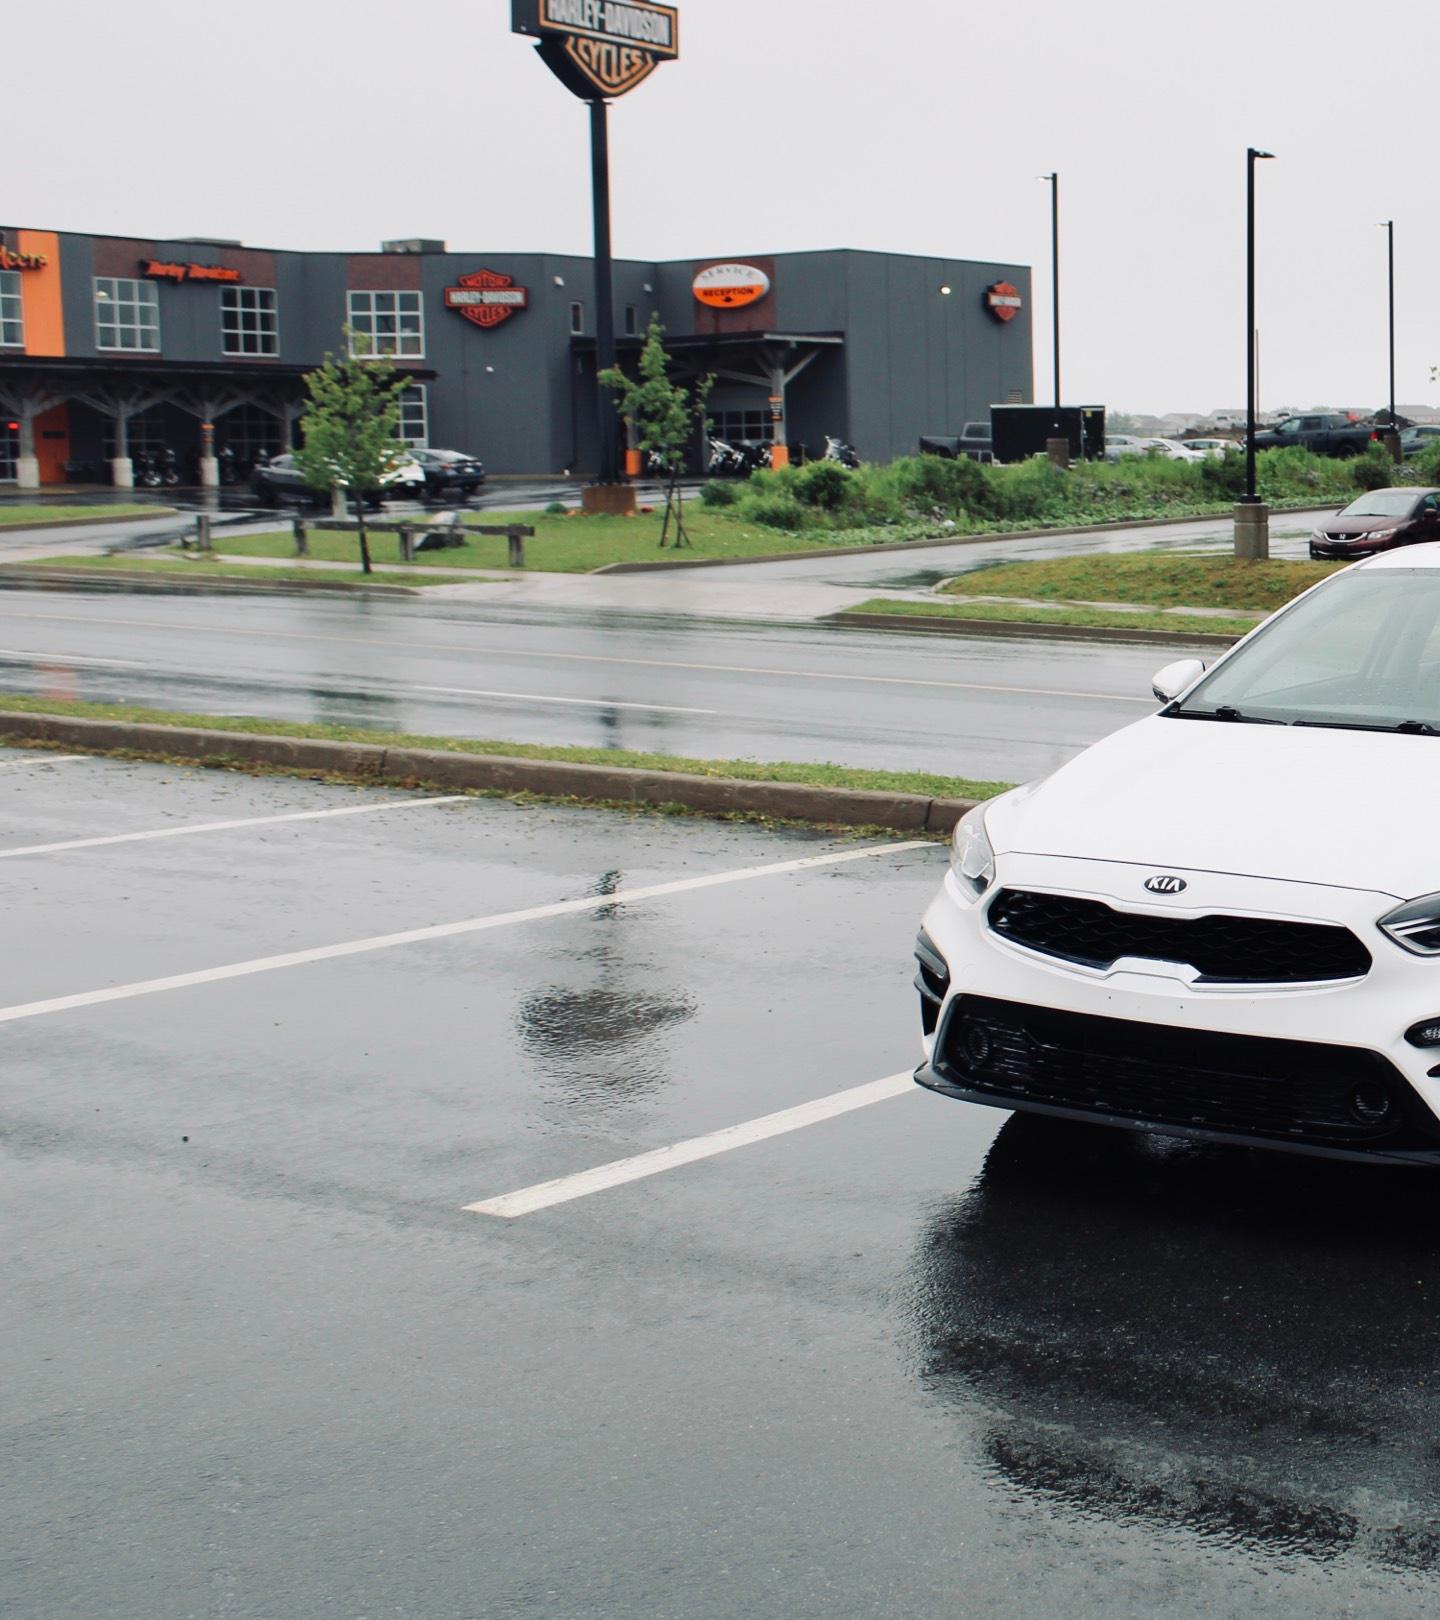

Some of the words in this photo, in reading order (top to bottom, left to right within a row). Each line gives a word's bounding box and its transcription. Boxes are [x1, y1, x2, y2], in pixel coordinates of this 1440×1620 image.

[577, 38, 643, 85] CYCLES
[701, 267, 754, 280] SERVICE
[702, 287, 755, 297] RECEPTION
[467, 306, 505, 322] CYCLES
[1147, 876, 1181, 892] KIA
